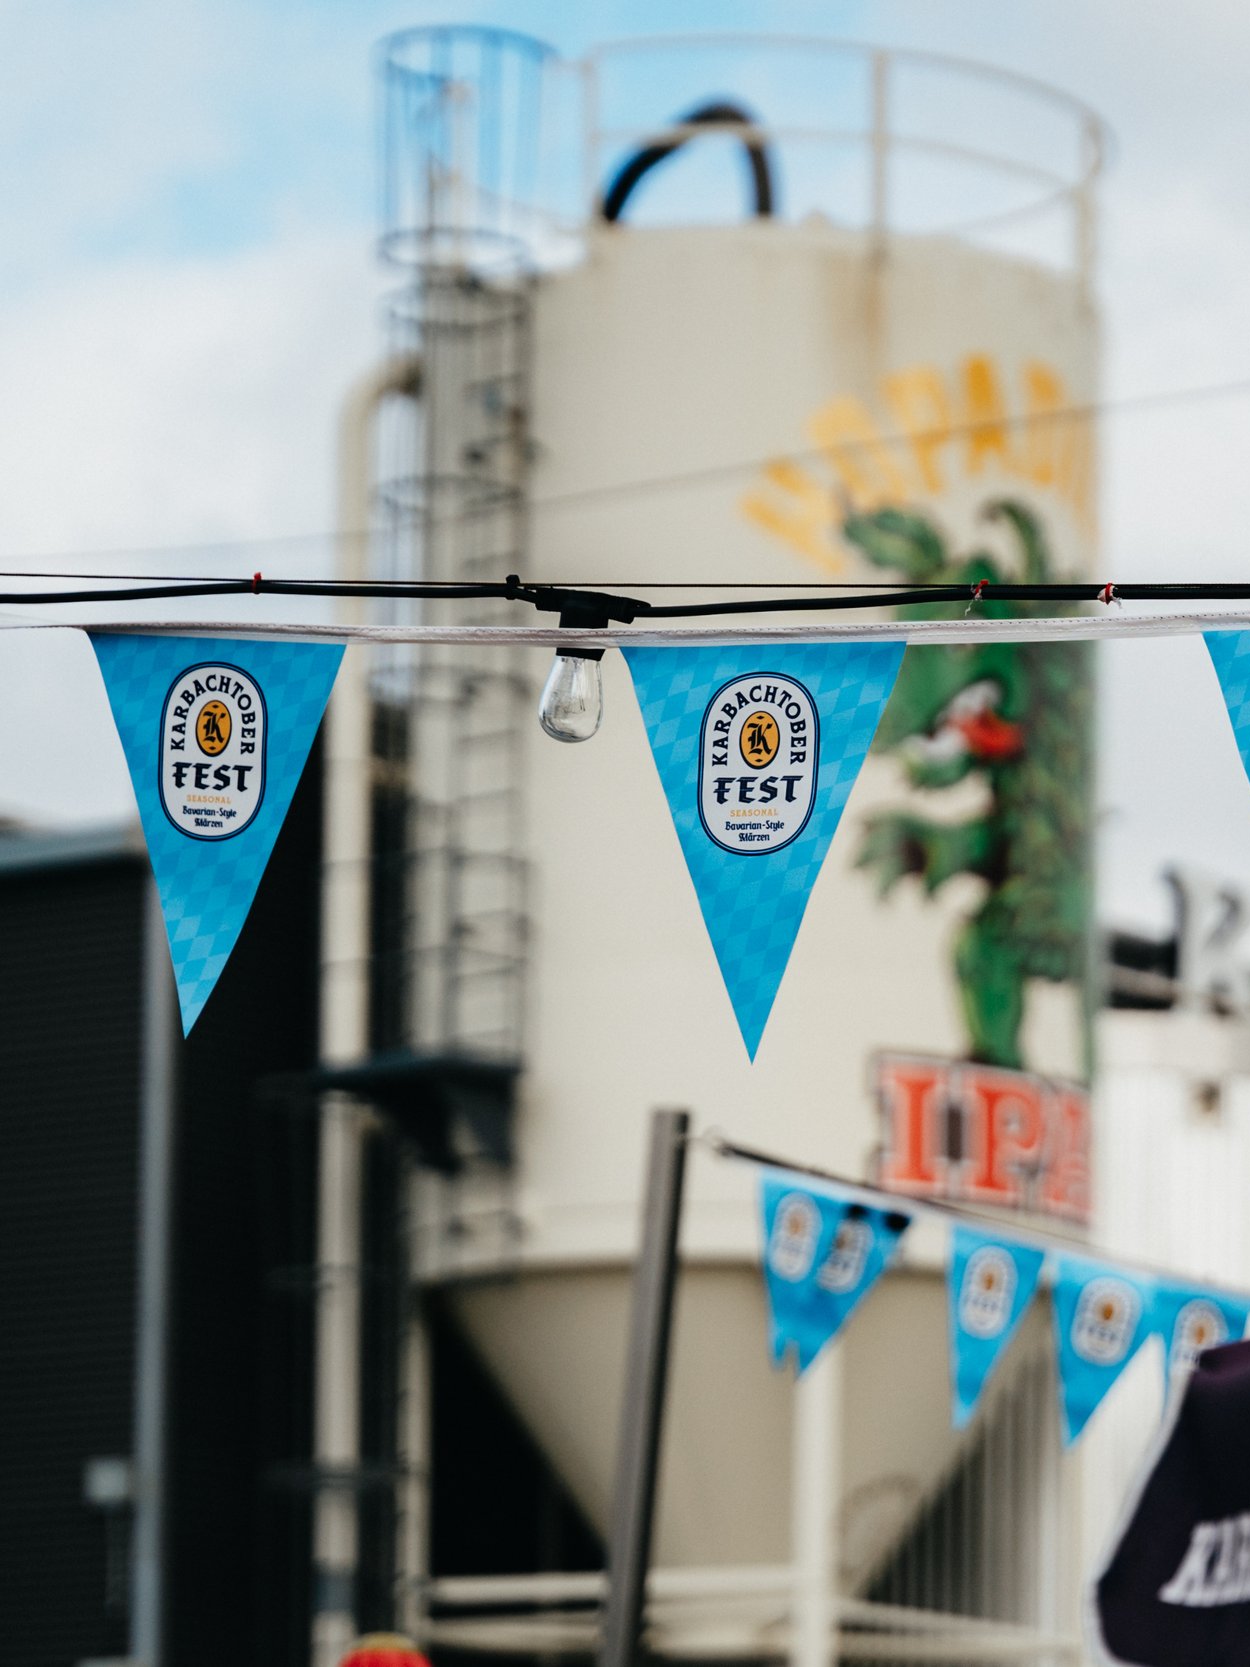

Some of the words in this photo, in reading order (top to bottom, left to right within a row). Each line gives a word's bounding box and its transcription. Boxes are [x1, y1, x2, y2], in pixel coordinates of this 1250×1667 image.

[171, 674, 257, 756] KARBACHTOBER
[202, 710, 227, 744] K
[711, 684, 807, 767] KARBACHTOBER
[747, 722, 773, 755] K
[171, 761, 254, 793] FEST
[712, 775, 804, 805] FEST
[182, 805, 237, 819] Bavarian-Style
[186, 794, 232, 804] SEASONAL
[729, 807, 779, 818] SEASONAL
[725, 820, 785, 832] Bavarian-Style
